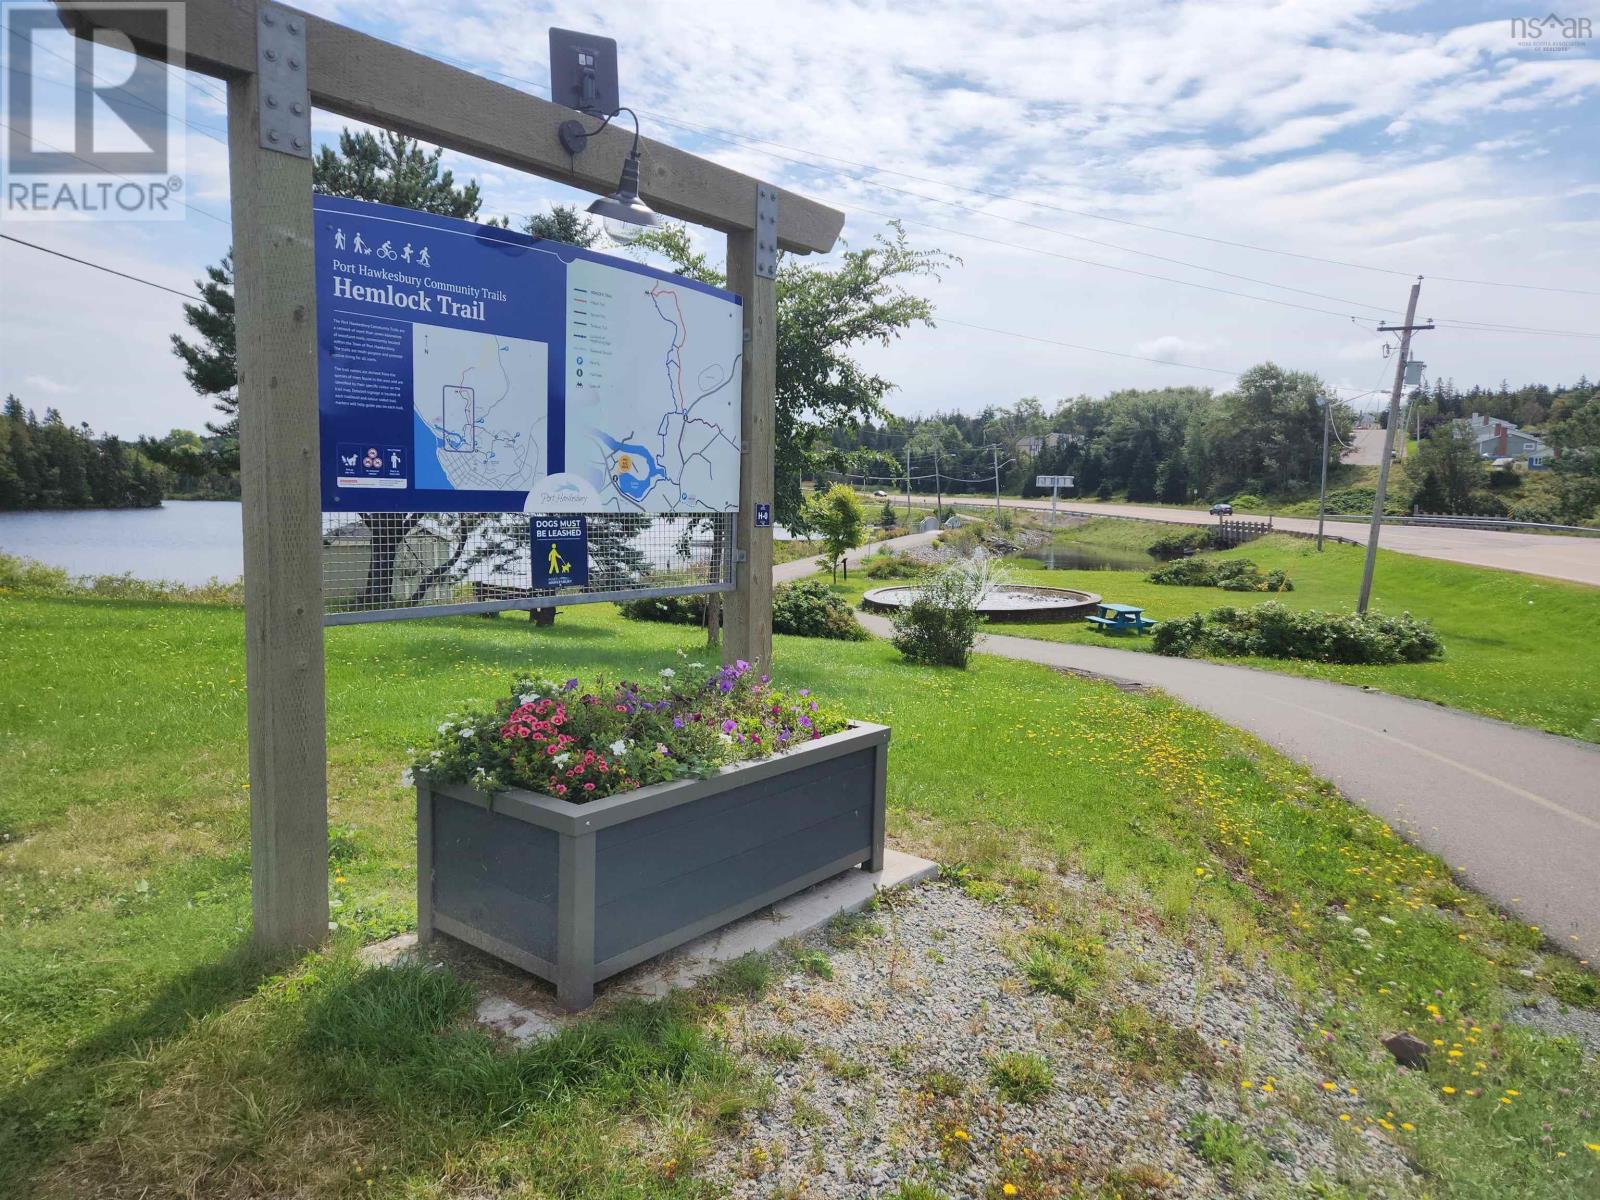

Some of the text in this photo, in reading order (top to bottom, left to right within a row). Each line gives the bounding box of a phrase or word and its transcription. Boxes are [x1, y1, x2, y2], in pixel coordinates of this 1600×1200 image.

[333, 259, 507, 302] Port Hawkesbury Community Trails
[333, 276, 486, 321] Hemlock Trail
[536, 519, 581, 528] DOGS MUST
[536, 529, 582, 537] BE LEASHED
